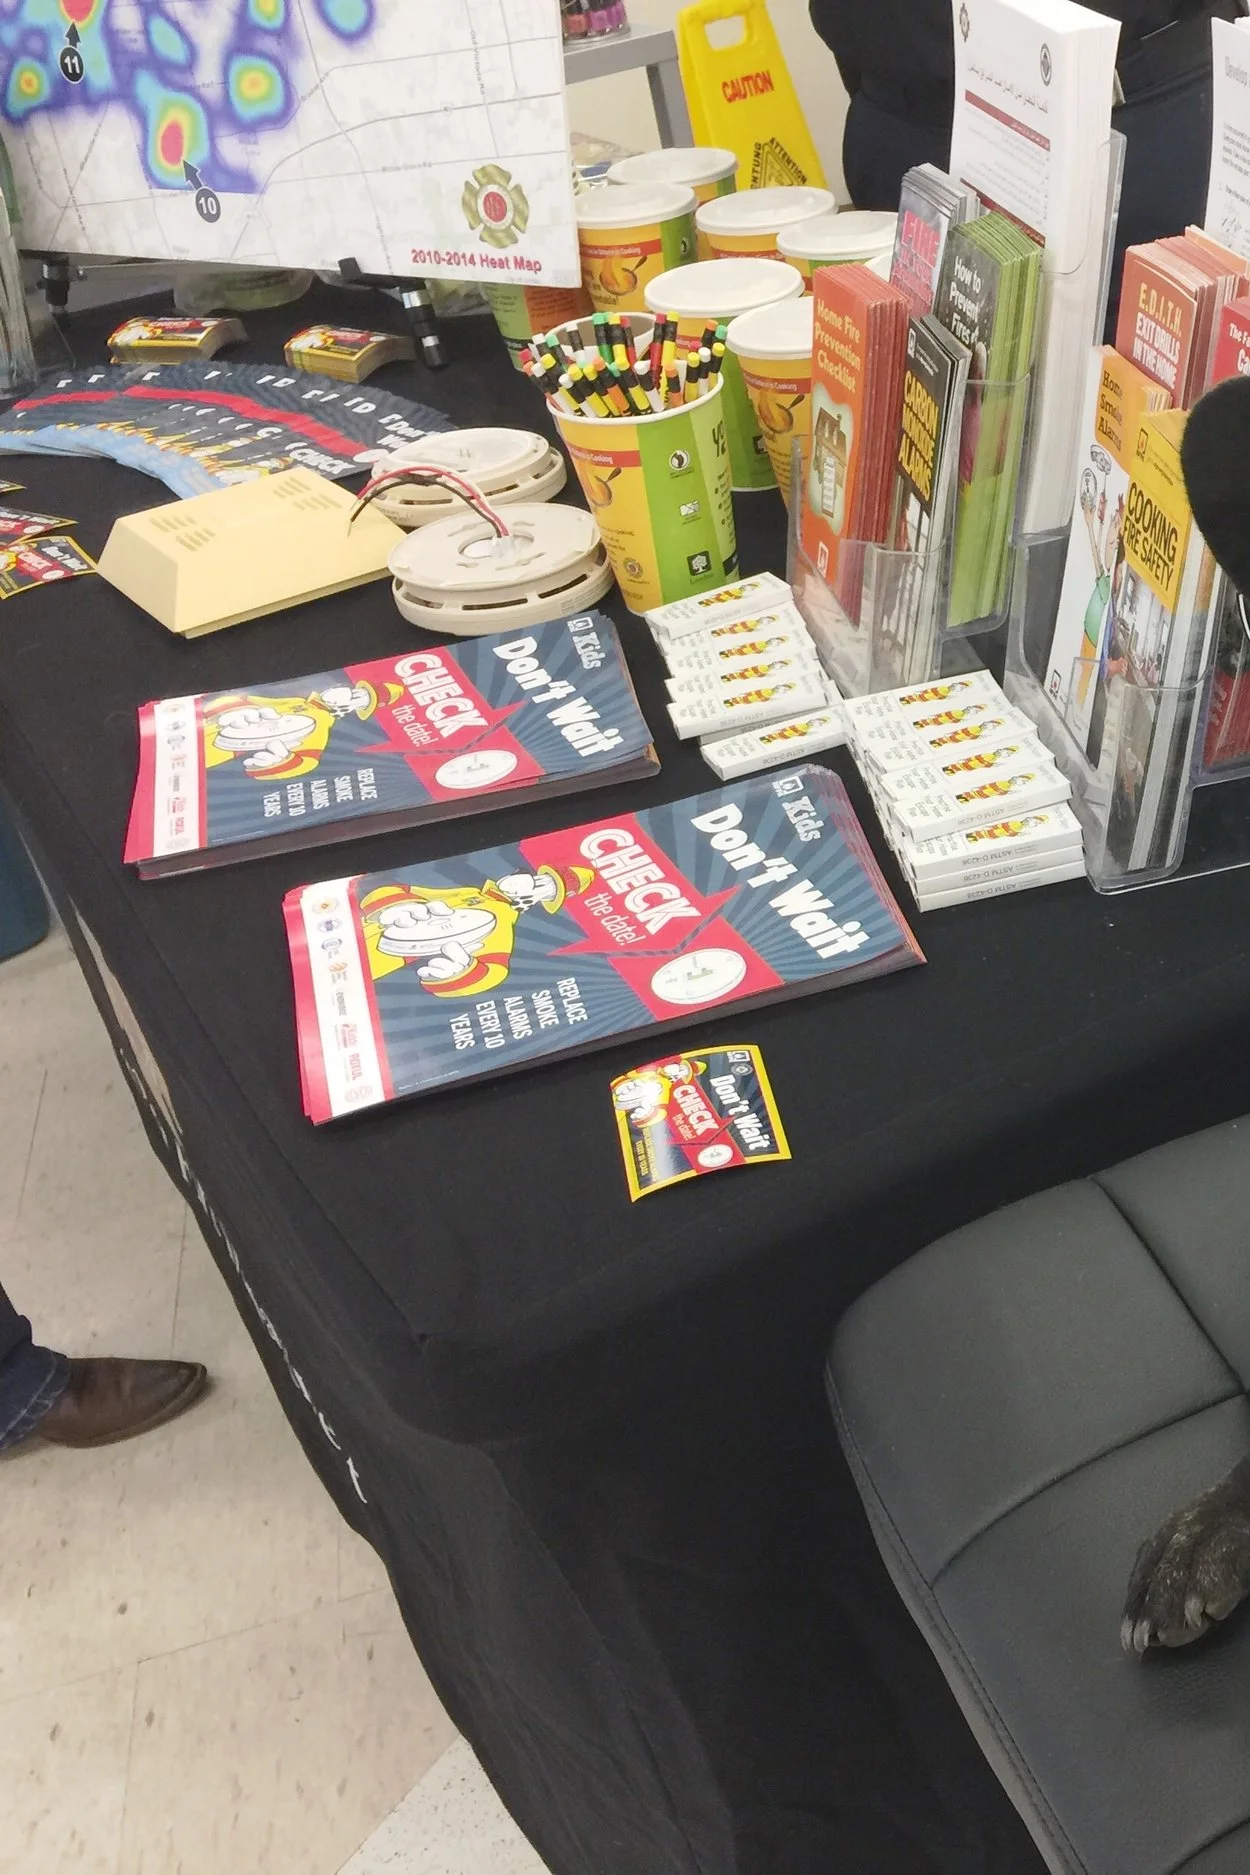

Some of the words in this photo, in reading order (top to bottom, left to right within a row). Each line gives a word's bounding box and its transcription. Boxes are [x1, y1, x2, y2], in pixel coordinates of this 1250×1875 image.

[64, 55, 80, 73] 11
[722, 70, 775, 103] CAUTION
[769, 137, 808, 185] ATTENTION
[199, 197, 217, 214] 10
[411, 249, 476, 267] 2010-2014
[480, 251, 510, 270] Heat
[513, 256, 542, 274] Map
[955, 255, 972, 284] How
[972, 274, 982, 294] to
[817, 299, 843, 331] Home
[844, 315, 861, 345] Fire
[950, 281, 981, 322] Prevent
[815, 322, 861, 370] Prevention
[951, 314, 971, 344] Fires
[1136, 312, 1156, 345] EXIT
[1155, 324, 1180, 366] DRILLS
[1229, 323, 1243, 342] The
[817, 350, 857, 394] Checklist
[1132, 337, 1142, 362] IN
[1141, 342, 1156, 372] THE
[1155, 356, 1177, 389] HOME
[904, 370, 939, 441] CARBON
[898, 432, 932, 502] ALARMS
[1127, 481, 1178, 565] COOKING
[1123, 515, 1142, 556] FIRE
[1141, 536, 1173, 592] SAFETY
[572, 631, 606, 670] Kids
[394, 653, 489, 739] CHECK
[492, 636, 577, 704] Don't
[546, 696, 624, 758] Wait
[392, 703, 410, 725] the
[402, 722, 440, 748] date!
[263, 791, 282, 818] YEARS
[286, 782, 305, 806] EVERY
[310, 779, 330, 810] ALARMS
[334, 775, 354, 803] SMOKE
[357, 768, 378, 801] REPLACE
[288, 806, 306, 817] 10
[782, 795, 824, 842] Kids
[579, 828, 702, 936] CHECK
[690, 803, 798, 888] Don't
[768, 879, 871, 959] Wait
[584, 893, 605, 918] the
[600, 914, 646, 946] date!
[475, 1000, 502, 1034] EVERY
[503, 995, 533, 1040] ALARMS
[531, 989, 560, 1029] SMOKE
[557, 977, 588, 1024] REPLACE
[450, 1013, 475, 1050] YEARS
[483, 1034, 505, 1049] 10
[672, 1114, 683, 1128] the
[678, 1125, 696, 1142] date!
[673, 1084, 720, 1136] CHECK
[709, 1074, 750, 1117] Don't
[733, 1112, 771, 1151] Wait
